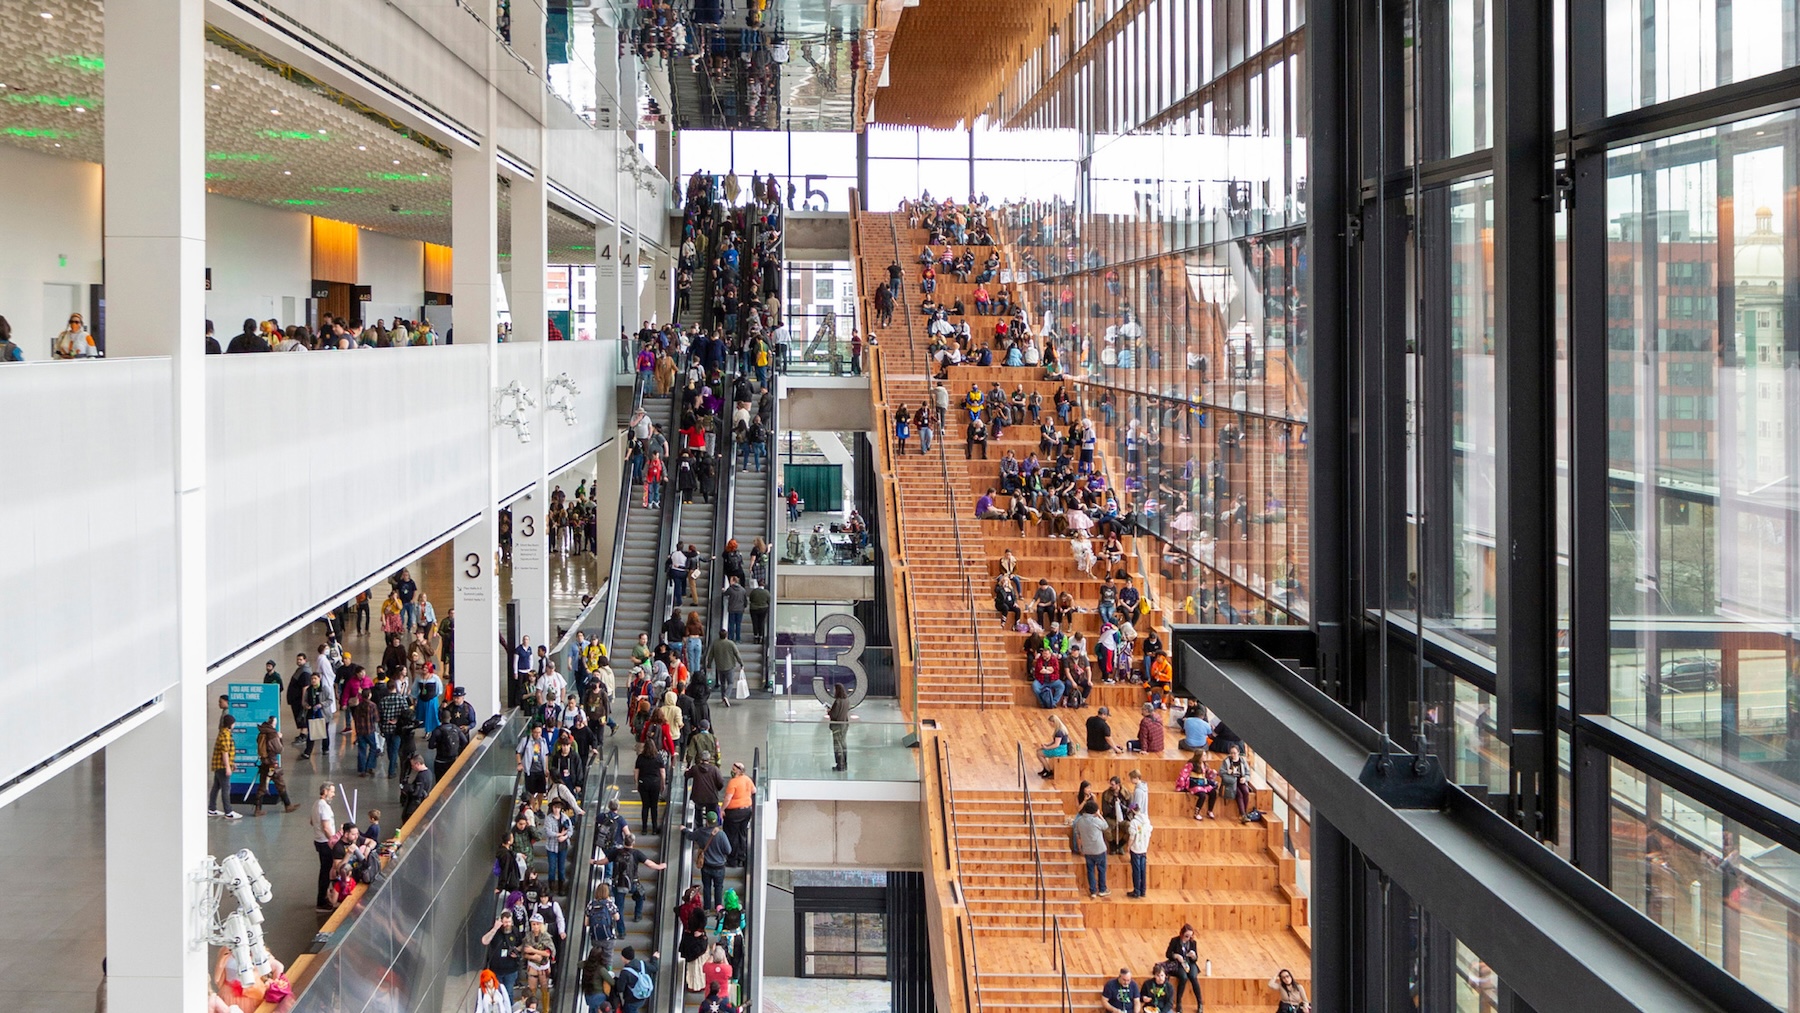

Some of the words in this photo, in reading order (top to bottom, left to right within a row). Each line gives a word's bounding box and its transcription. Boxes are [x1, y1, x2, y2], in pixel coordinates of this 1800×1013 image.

[805, 174, 829, 211] 5
[601, 244, 611, 260] 4
[622, 253, 631, 267] 4
[659, 269, 667, 281] 4
[804, 312, 843, 376] 4
[521, 515, 535, 537] 3
[465, 552, 481, 579] 3
[812, 613, 868, 710] 3
